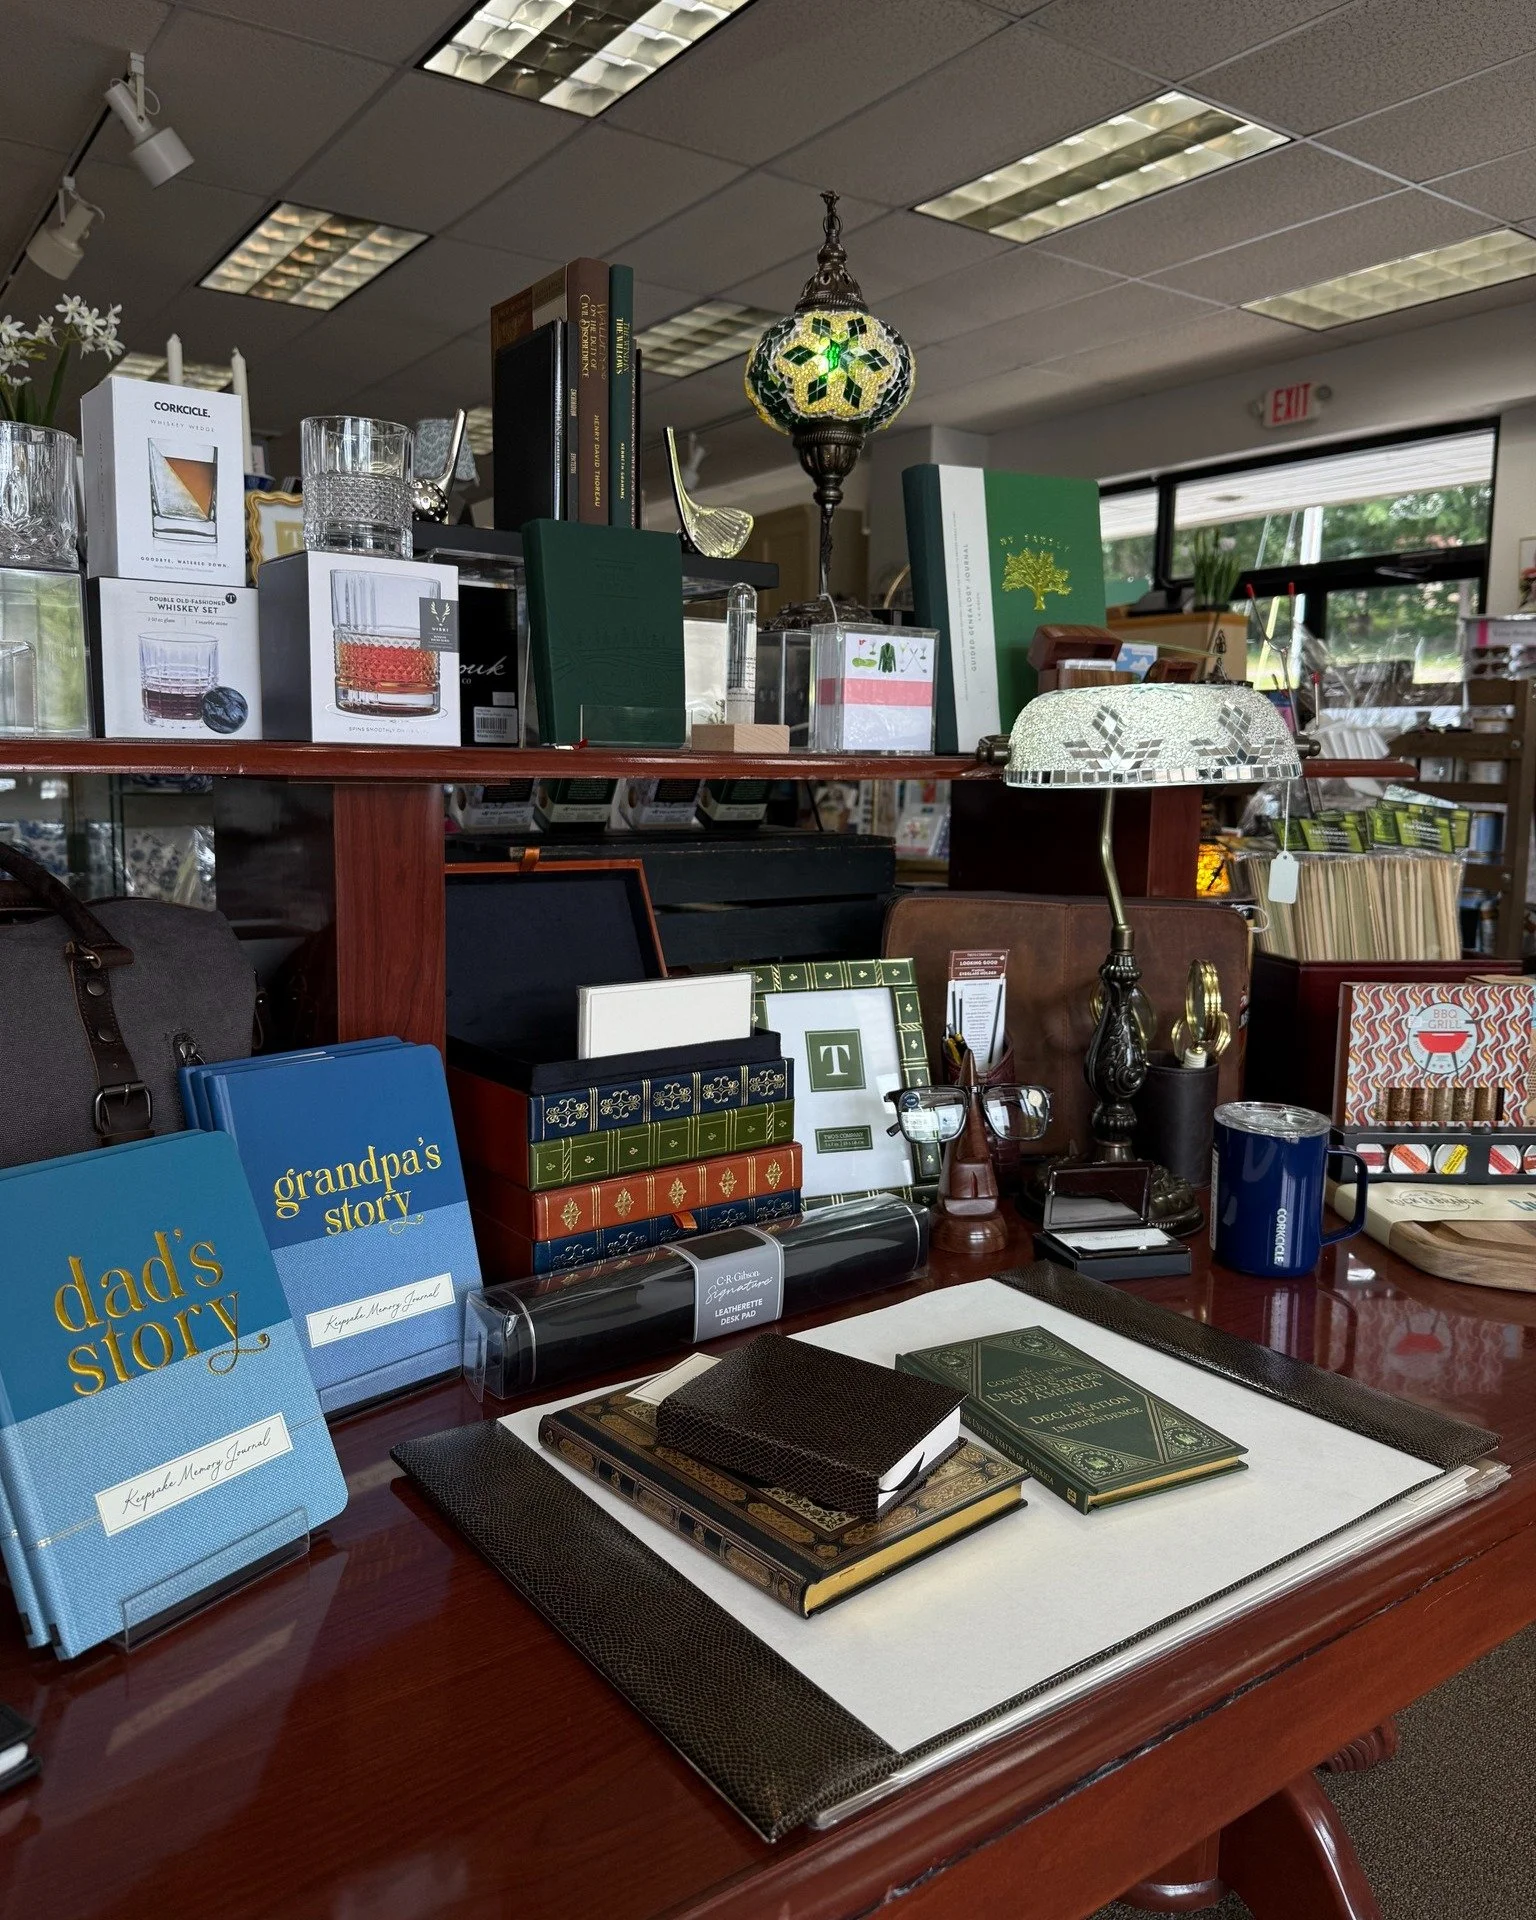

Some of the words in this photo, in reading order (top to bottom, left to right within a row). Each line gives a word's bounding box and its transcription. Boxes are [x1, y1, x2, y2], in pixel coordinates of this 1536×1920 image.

[580, 294, 590, 316] CIVIL
[590, 304, 597, 317] ON
[616, 317, 624, 336] THE
[580, 318, 590, 379] DISOBEDIENCE
[616, 336, 624, 375] WILLOWS
[590, 359, 598, 370] OF
[154, 401, 211, 418] CORKCICLE.
[1272, 383, 1311, 424] EXIT
[150, 419, 184, 428] WHISKEY
[189, 423, 215, 432] WEDGE
[963, 544, 971, 584] JOURNAL
[157, 603, 199, 613] WHISKEY
[202, 605, 218, 614] SET
[176, 597, 226, 606] OLD-FASHIONED
[965, 586, 975, 639] GENEALOGY
[1428, 1019, 1462, 1029] GRILL
[1433, 1008, 1458, 1019] BBQ
[820, 1044, 850, 1076] T
[273, 1136, 442, 1219] grandpa's
[324, 1190, 424, 1235] story
[54, 1227, 224, 1332] dad's
[705, 1276, 773, 1305] Signature
[324, 1306, 365, 1334] Keepsake
[366, 1302, 402, 1319] Memory
[402, 1283, 441, 1312] Journal
[714, 1298, 763, 1317] LEATHERETTE
[720, 1314, 740, 1326] DESK
[741, 1309, 757, 1320] PAD
[67, 1291, 271, 1396] story
[986, 1365, 1072, 1388] CONSTITUTION
[986, 1384, 1048, 1402] UNITED
[1048, 1371, 1102, 1387] STATES
[1019, 1379, 1031, 1387] OF
[1010, 1397, 1029, 1406] OF
[1034, 1380, 1103, 1401] AMERICA
[1028, 1395, 1131, 1424] DECLARATION
[1051, 1406, 1143, 1433] INDEPENDENCE
[972, 1419, 995, 1441] UNITED
[994, 1436, 1017, 1458] STATES
[1016, 1453, 1024, 1462] OF
[1025, 1459, 1054, 1485] AMERICA
[122, 1472, 176, 1514] Keepsake
[177, 1459, 223, 1486] Memory
[225, 1427, 271, 1471] Journal
